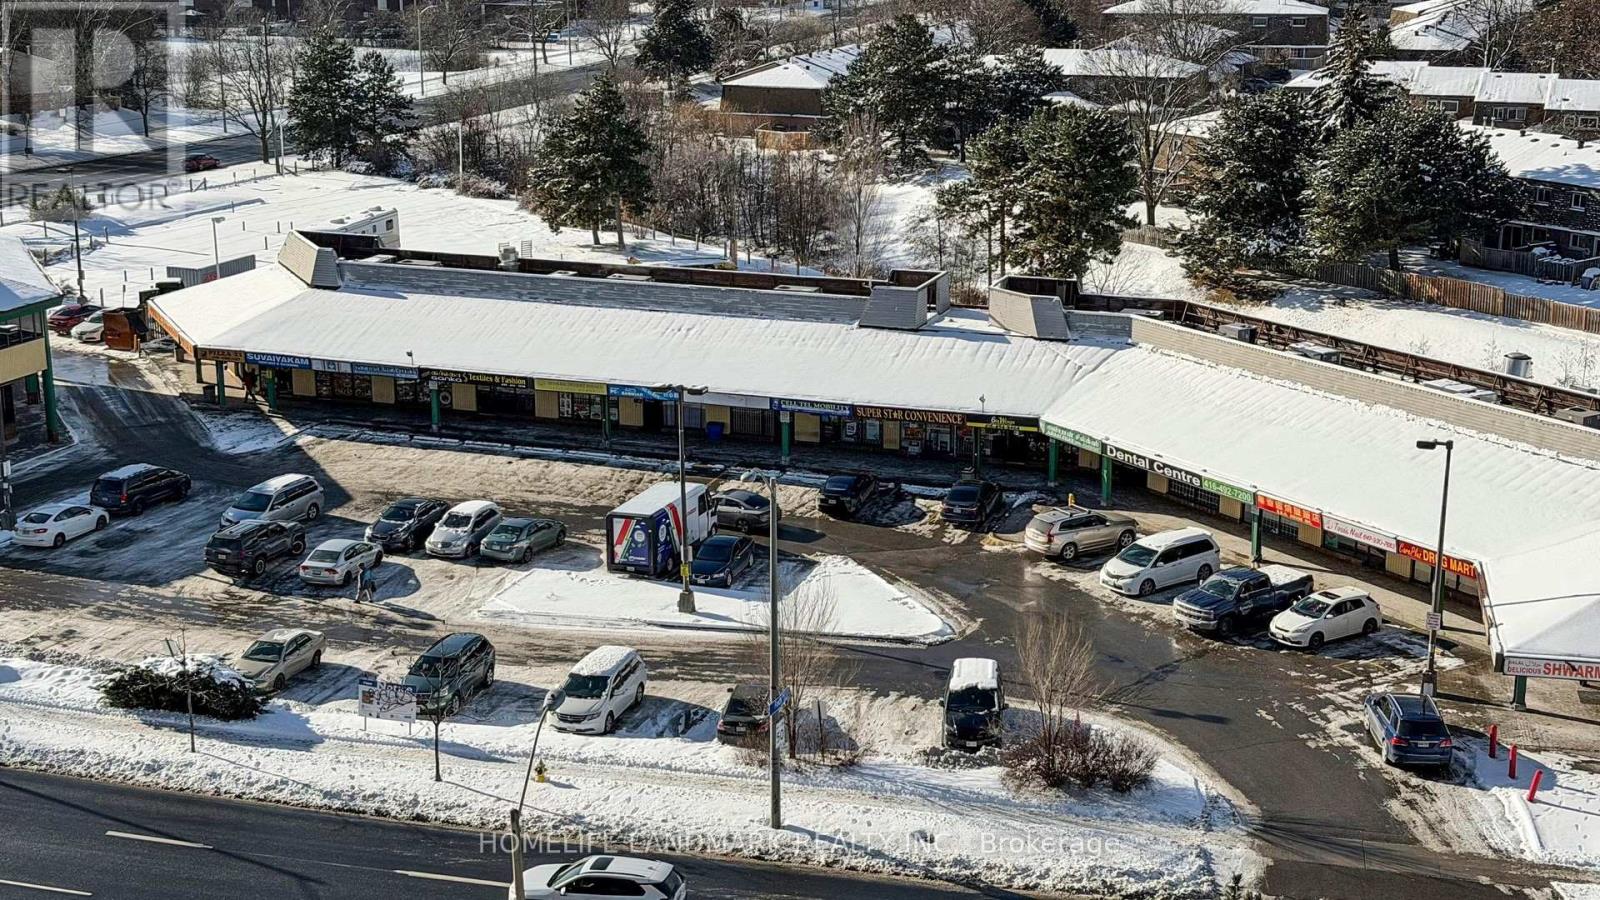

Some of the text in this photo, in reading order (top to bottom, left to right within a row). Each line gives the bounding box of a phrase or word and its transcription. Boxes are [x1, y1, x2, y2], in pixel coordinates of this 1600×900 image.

[246, 352, 310, 365] SUVAIYAKAM
[469, 373, 494, 382] Textiles
[813, 403, 850, 411] MOBILITY
[856, 407, 882, 419] SUPER
[904, 410, 963, 425] CONVENIENCE
[1106, 444, 1201, 487] Dental Centre
[1422, 549, 1448, 568] DRG
[1449, 558, 1474, 577] MART
[1507, 666, 1542, 675] DELICIOUS
